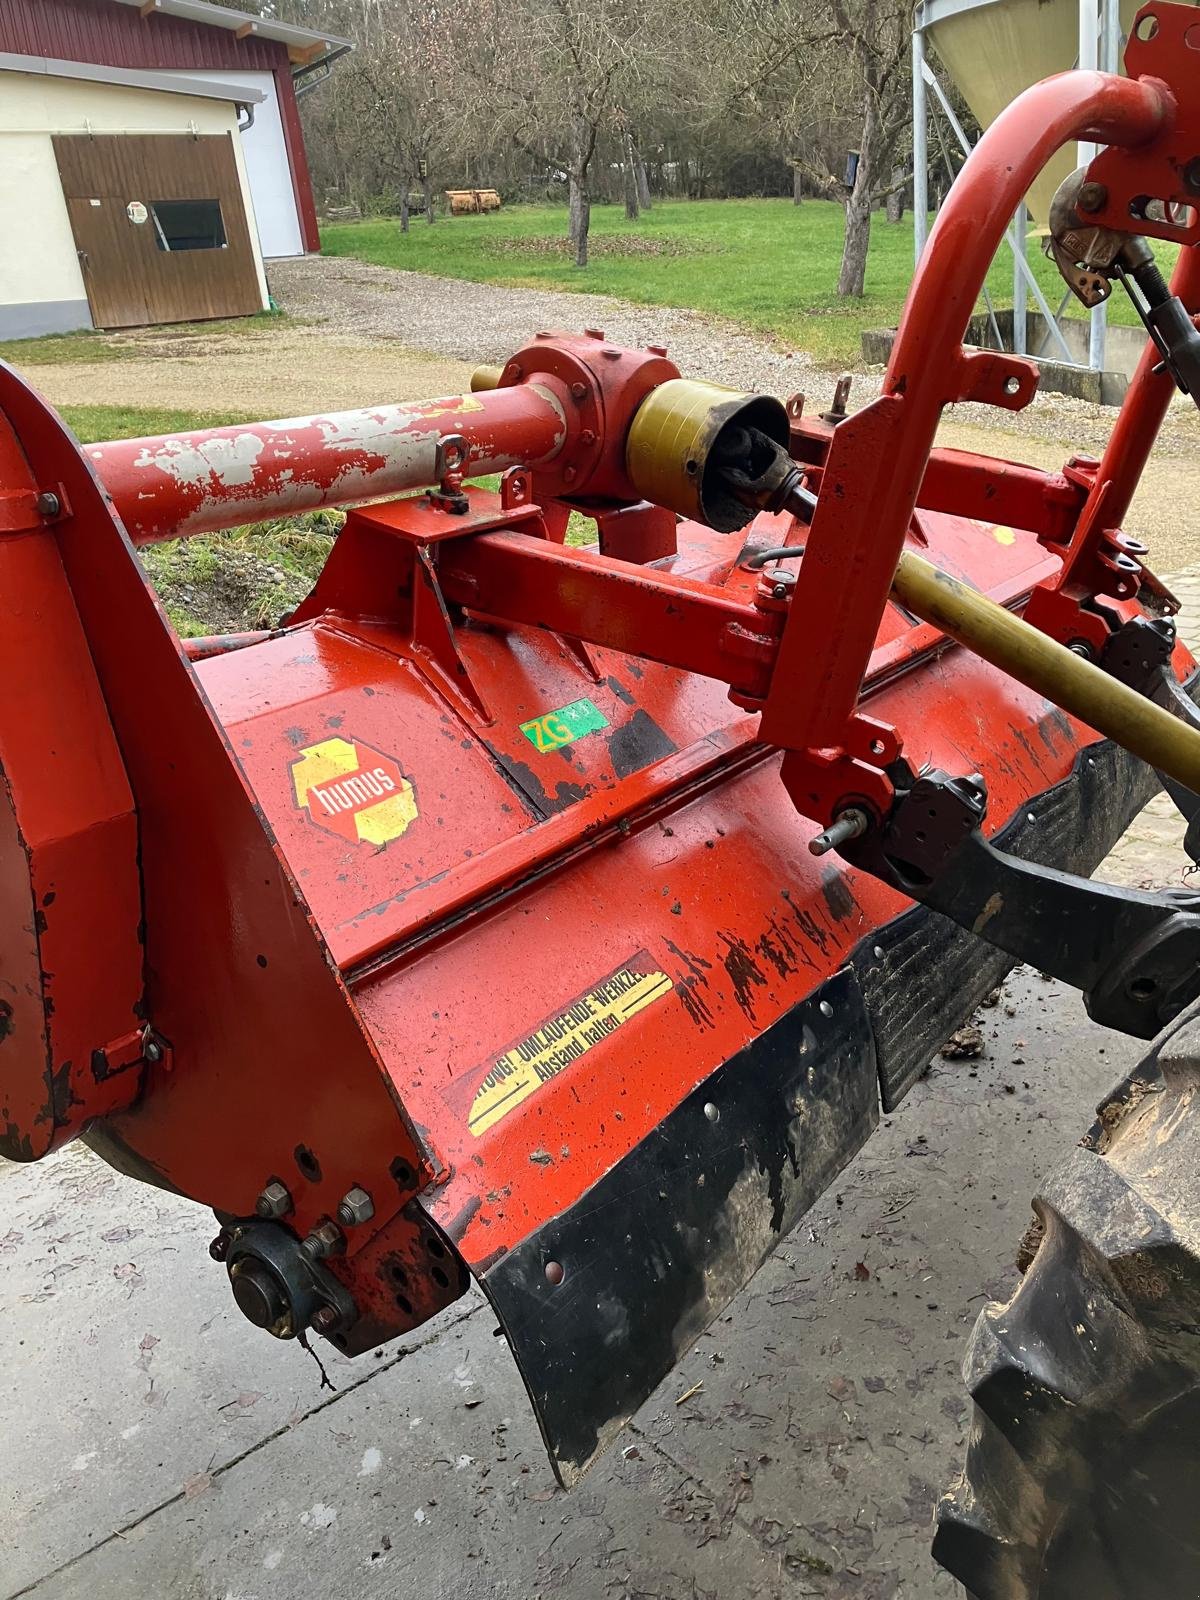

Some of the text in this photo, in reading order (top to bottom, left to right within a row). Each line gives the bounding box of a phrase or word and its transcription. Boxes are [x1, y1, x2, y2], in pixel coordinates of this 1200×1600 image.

[311, 767, 395, 815] humus
[514, 997, 598, 1062] UMLAUFENDE
[532, 1012, 621, 1083] Abstand halten
